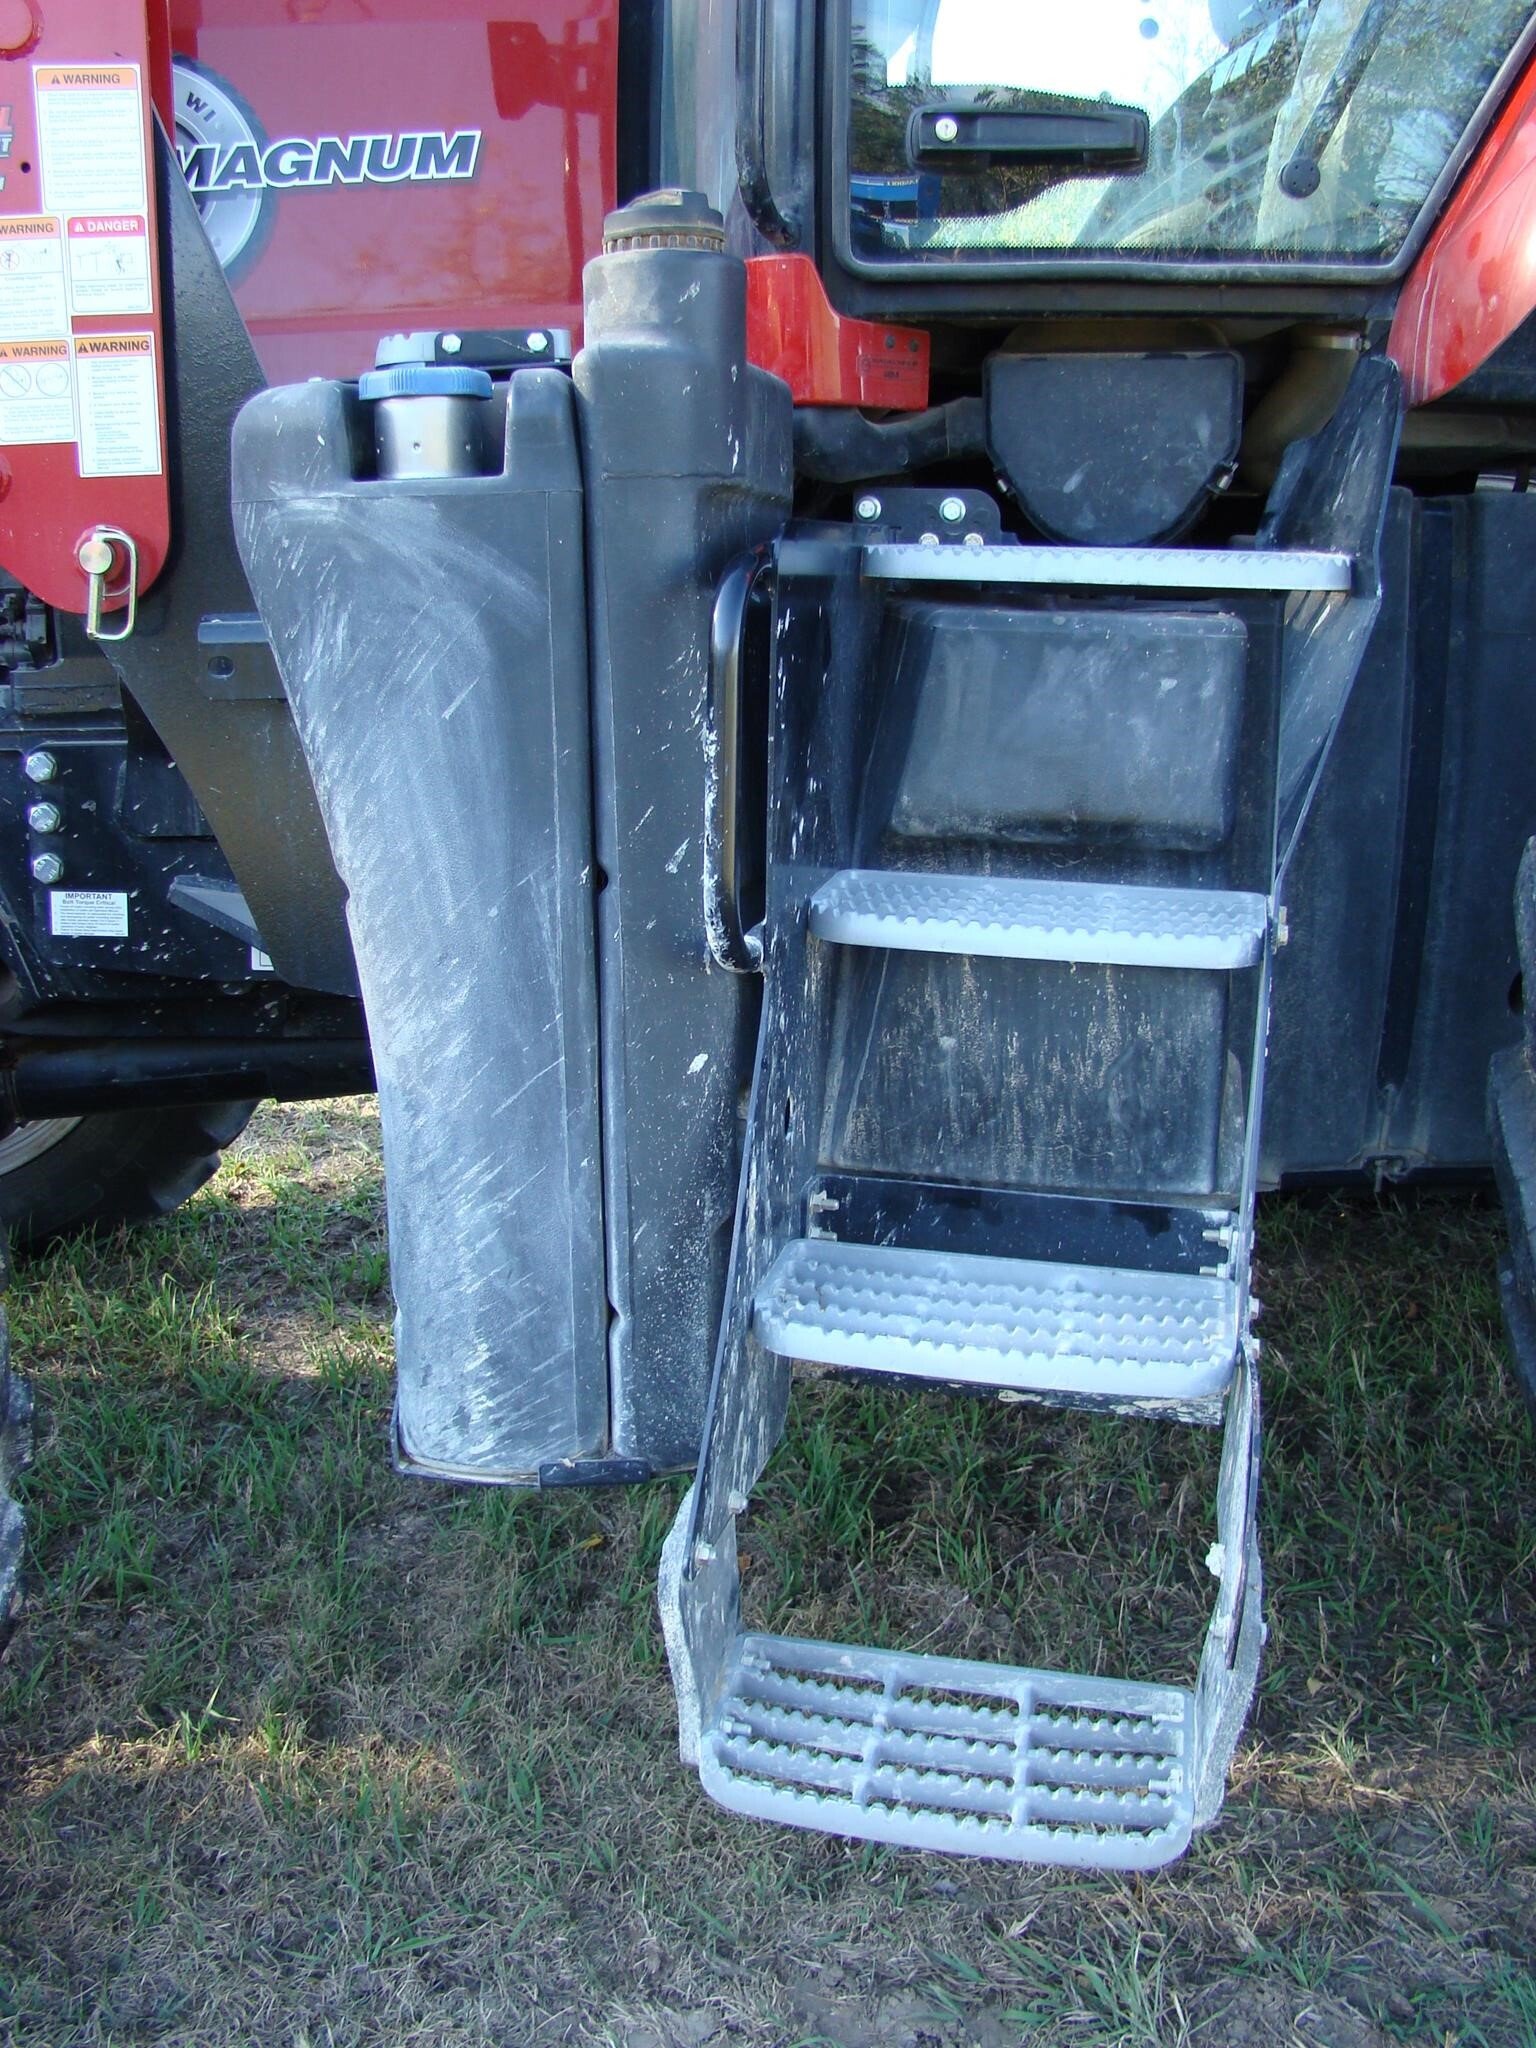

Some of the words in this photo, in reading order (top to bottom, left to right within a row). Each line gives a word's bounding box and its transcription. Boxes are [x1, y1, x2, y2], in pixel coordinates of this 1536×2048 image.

[63, 74, 121, 84] WARNING
[87, 220, 139, 232] DANGER
[12, 345, 68, 357] WARNING
[89, 340, 150, 351] WARNING
